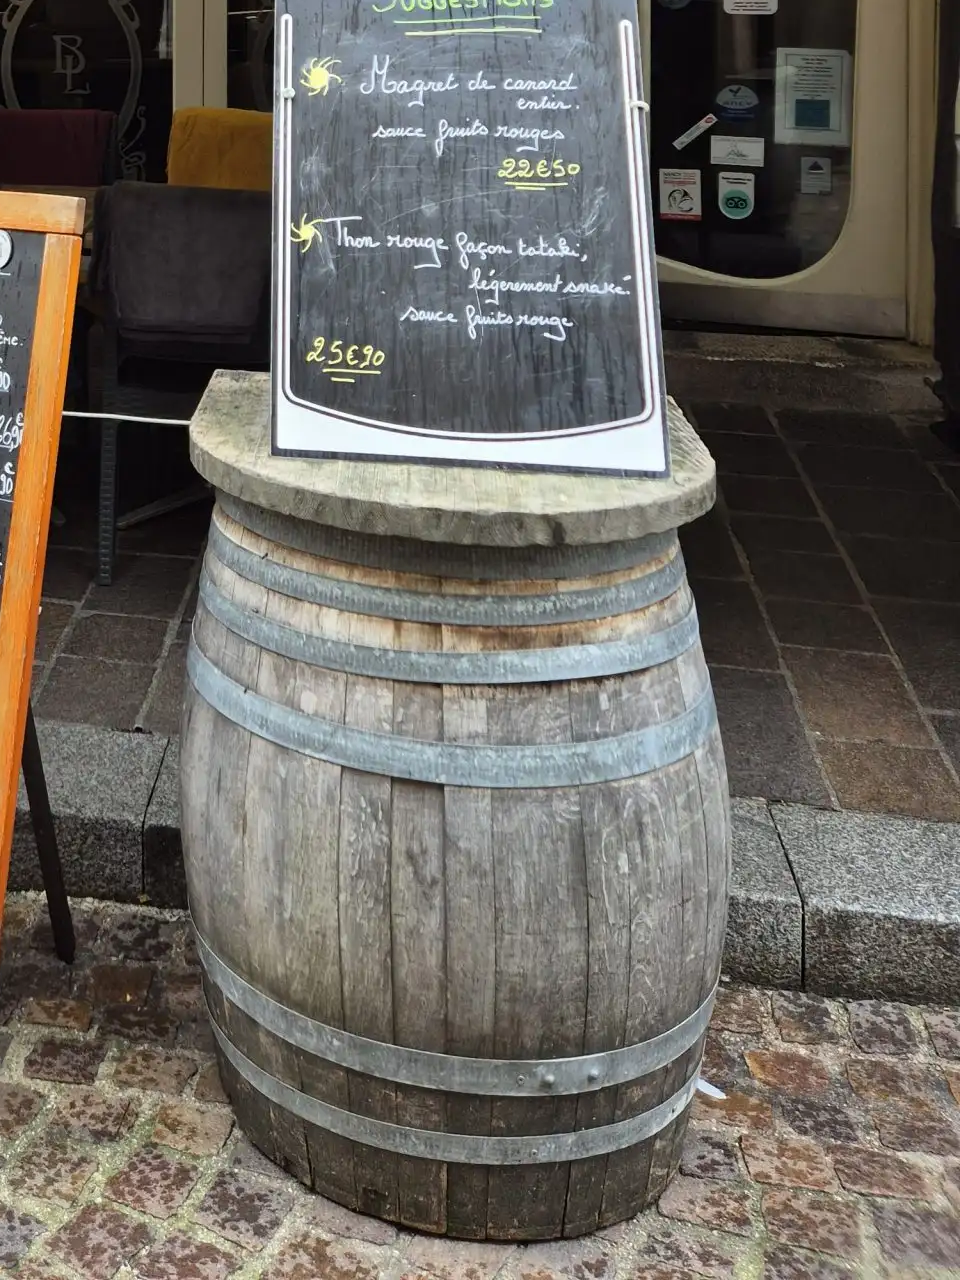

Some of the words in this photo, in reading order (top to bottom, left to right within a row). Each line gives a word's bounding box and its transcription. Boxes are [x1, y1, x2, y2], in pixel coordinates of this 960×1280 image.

[360, 54, 460, 108] Magret
[468, 71, 496, 91] de
[504, 72, 578, 93] canard
[372, 123, 426, 139] sauce
[438, 118, 489, 156] fruits
[494, 126, 565, 152] rouges
[323, 216, 380, 248] Thon
[388, 234, 448, 269] rouge
[456, 232, 512, 269] façon
[400, 306, 457, 322] sauce
[466, 306, 514, 339] fruits
[517, 313, 573, 342] rouge
